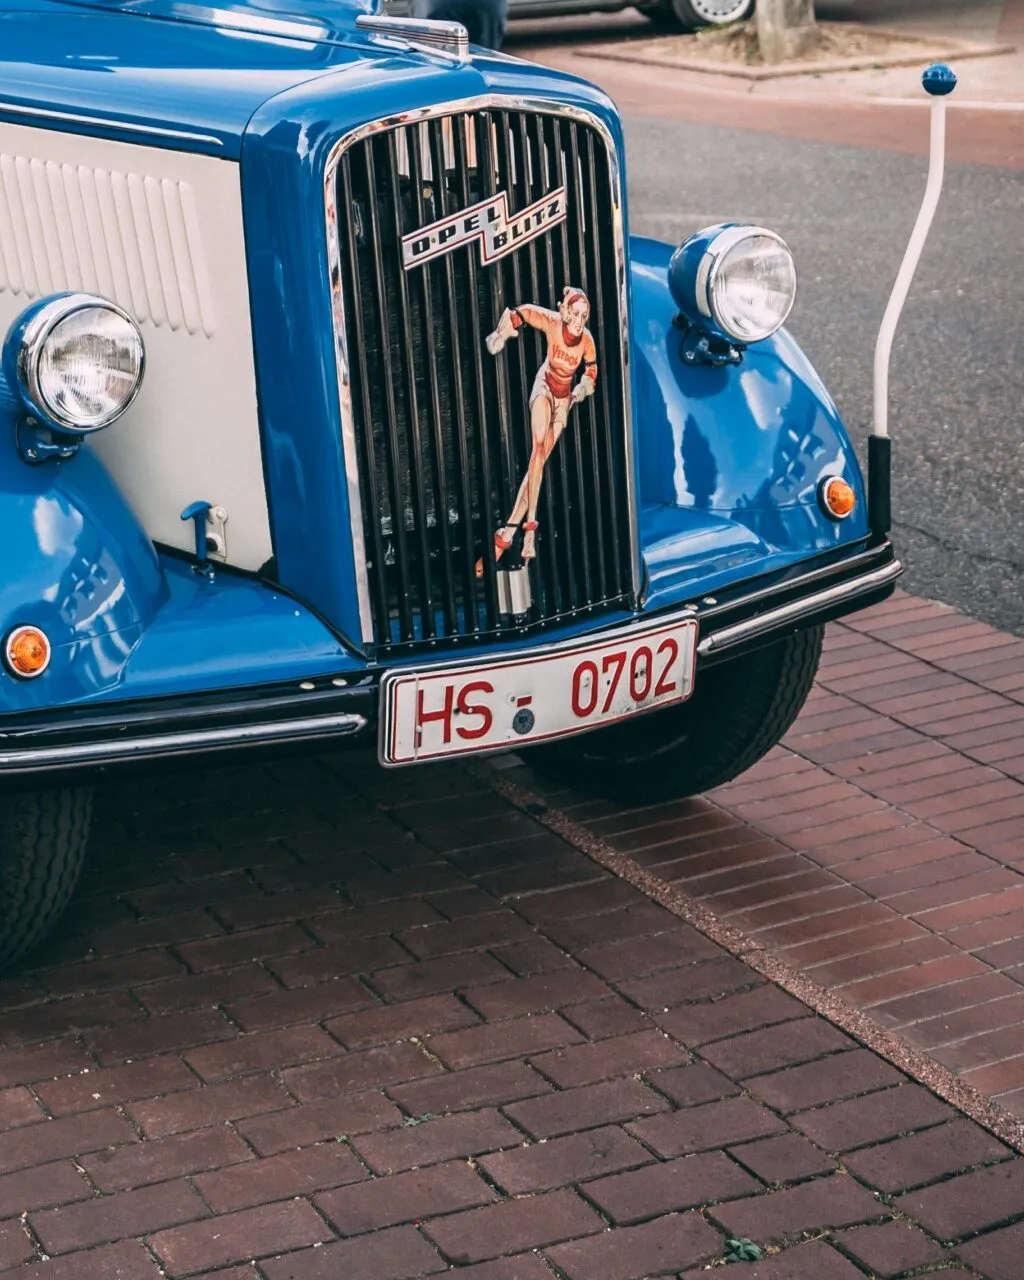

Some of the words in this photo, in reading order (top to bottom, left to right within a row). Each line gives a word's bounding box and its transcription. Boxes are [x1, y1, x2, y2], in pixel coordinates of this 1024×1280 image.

[412, 207, 500, 256] OPEL
[493, 200, 560, 250] BLITZ
[572, 638, 679, 718] 0702
